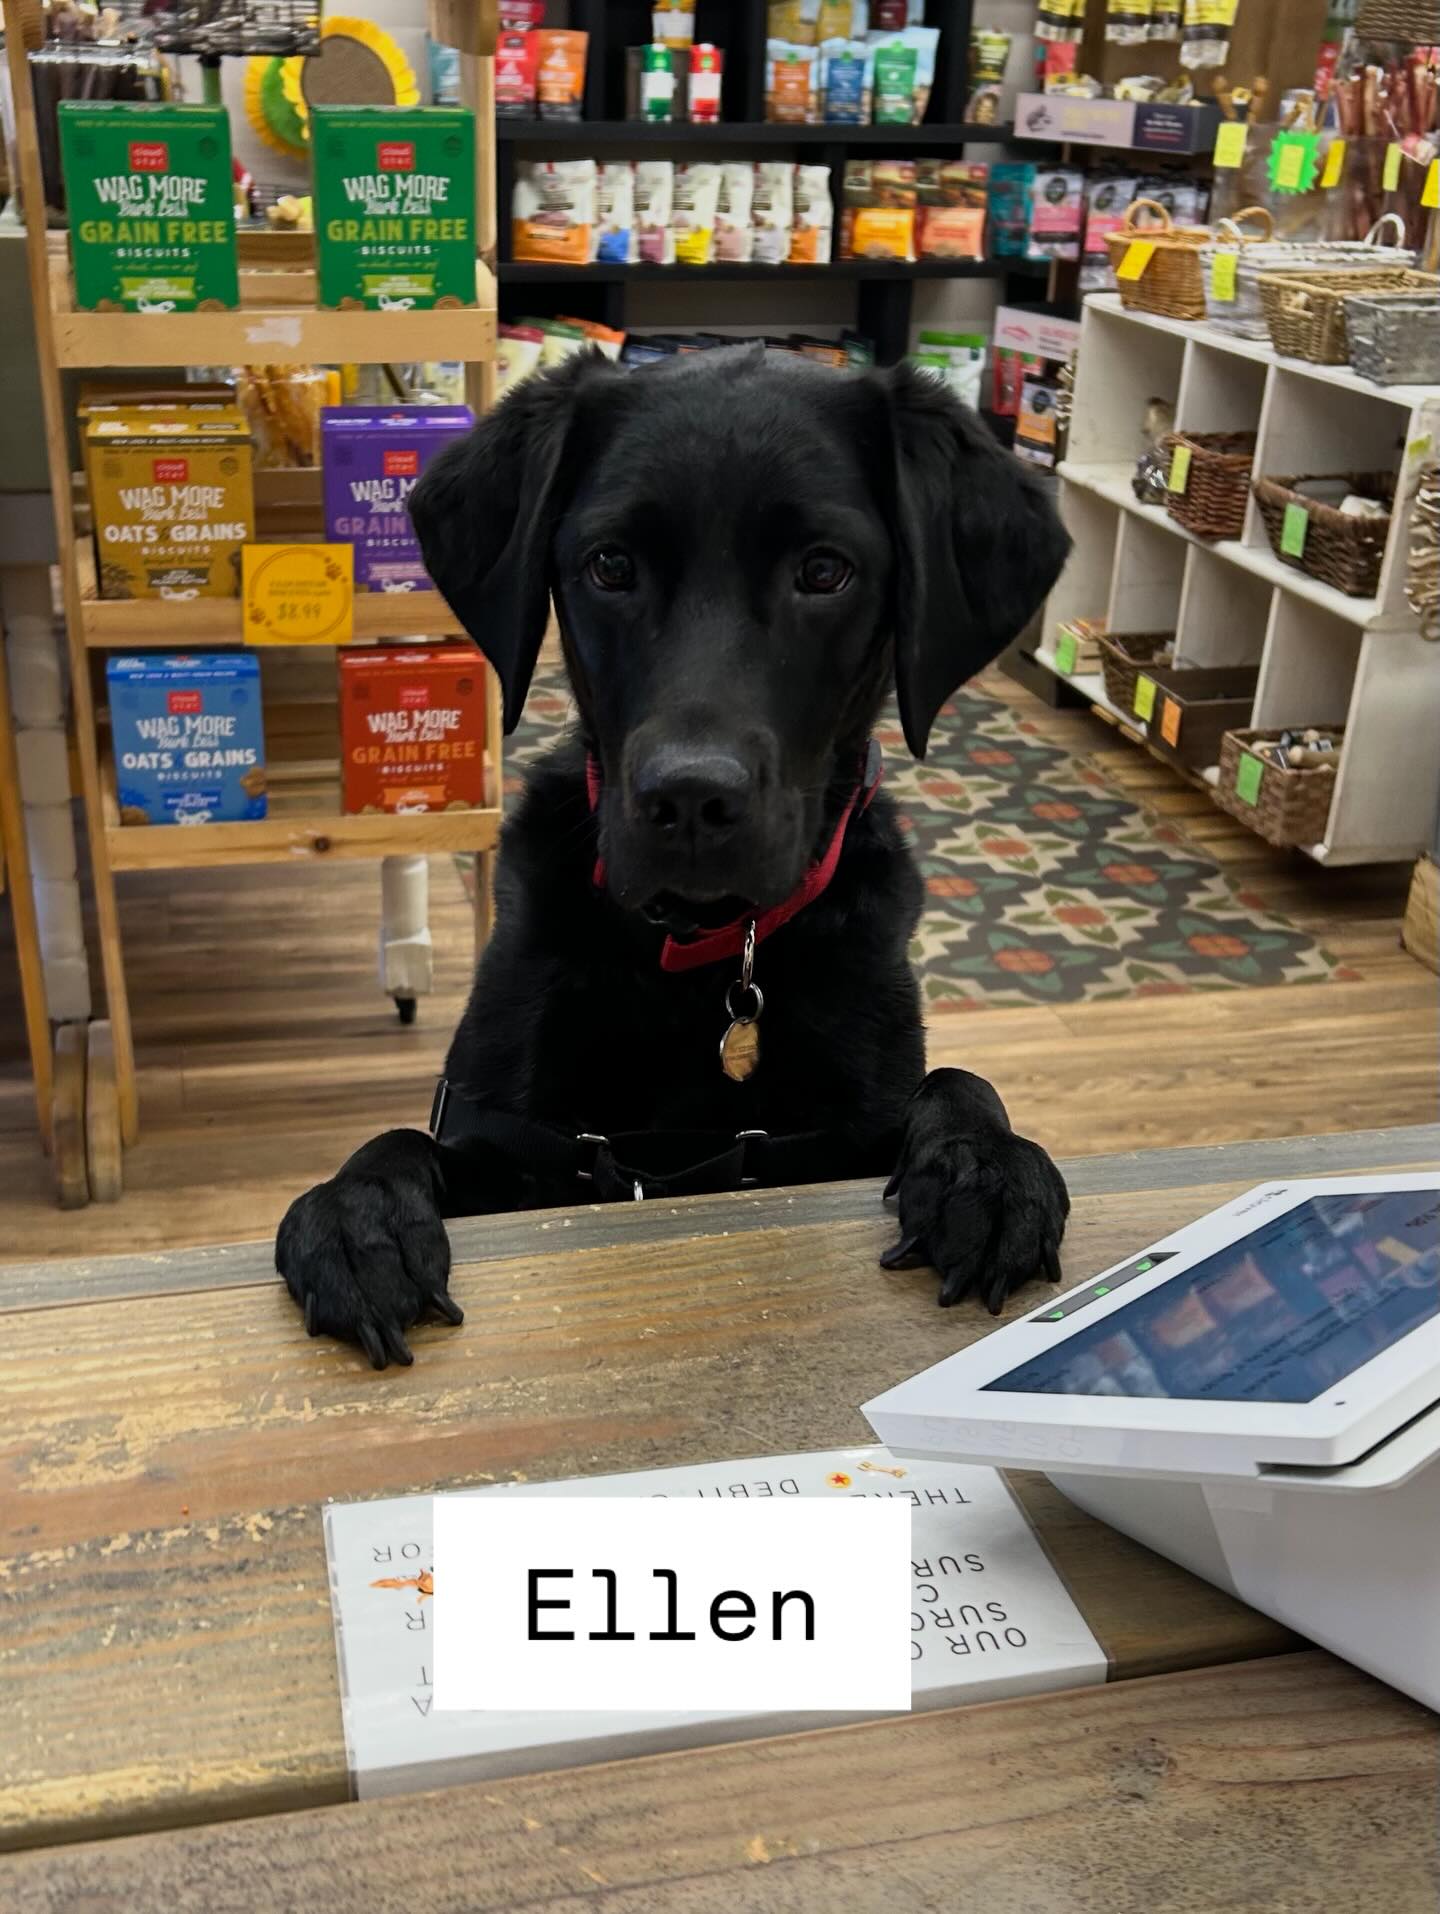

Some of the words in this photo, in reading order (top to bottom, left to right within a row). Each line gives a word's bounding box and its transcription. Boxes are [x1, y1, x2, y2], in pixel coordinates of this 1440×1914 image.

[93, 175, 143, 203] WAG
[148, 175, 208, 204] MORE
[342, 174, 390, 203] WAG
[395, 174, 451, 202] MORE
[79, 219, 160, 244] GRAIN
[167, 219, 228, 244] FREE
[327, 218, 404, 242] GRAIN
[409, 218, 468, 241] FREE
[116, 248, 191, 258] BISCUITS
[361, 245, 432, 256] BISCUITS
[118, 486, 165, 511] WAG
[170, 485, 226, 509] MORE
[349, 478, 395, 503] WAG
[104, 524, 159, 543] OATS
[170, 522, 247, 542] GRAINS
[335, 516, 408, 536] GRAIN
[140, 545, 212, 556] BISCUITS
[366, 538, 416, 547] BISCUI
[135, 715, 180, 740] WAG
[184, 715, 237, 737] MORE
[367, 710, 409, 734] WAG
[413, 709, 462, 730] MORE
[122, 752, 174, 770] OATS
[183, 748, 257, 768] GRAINS
[352, 744, 420, 765] GRAIN
[425, 740, 476, 761] FREE
[157, 769, 223, 781] BISCUITS
[380, 762, 445, 775] BISCUITS
[945, 1627, 1028, 1656] OUR
